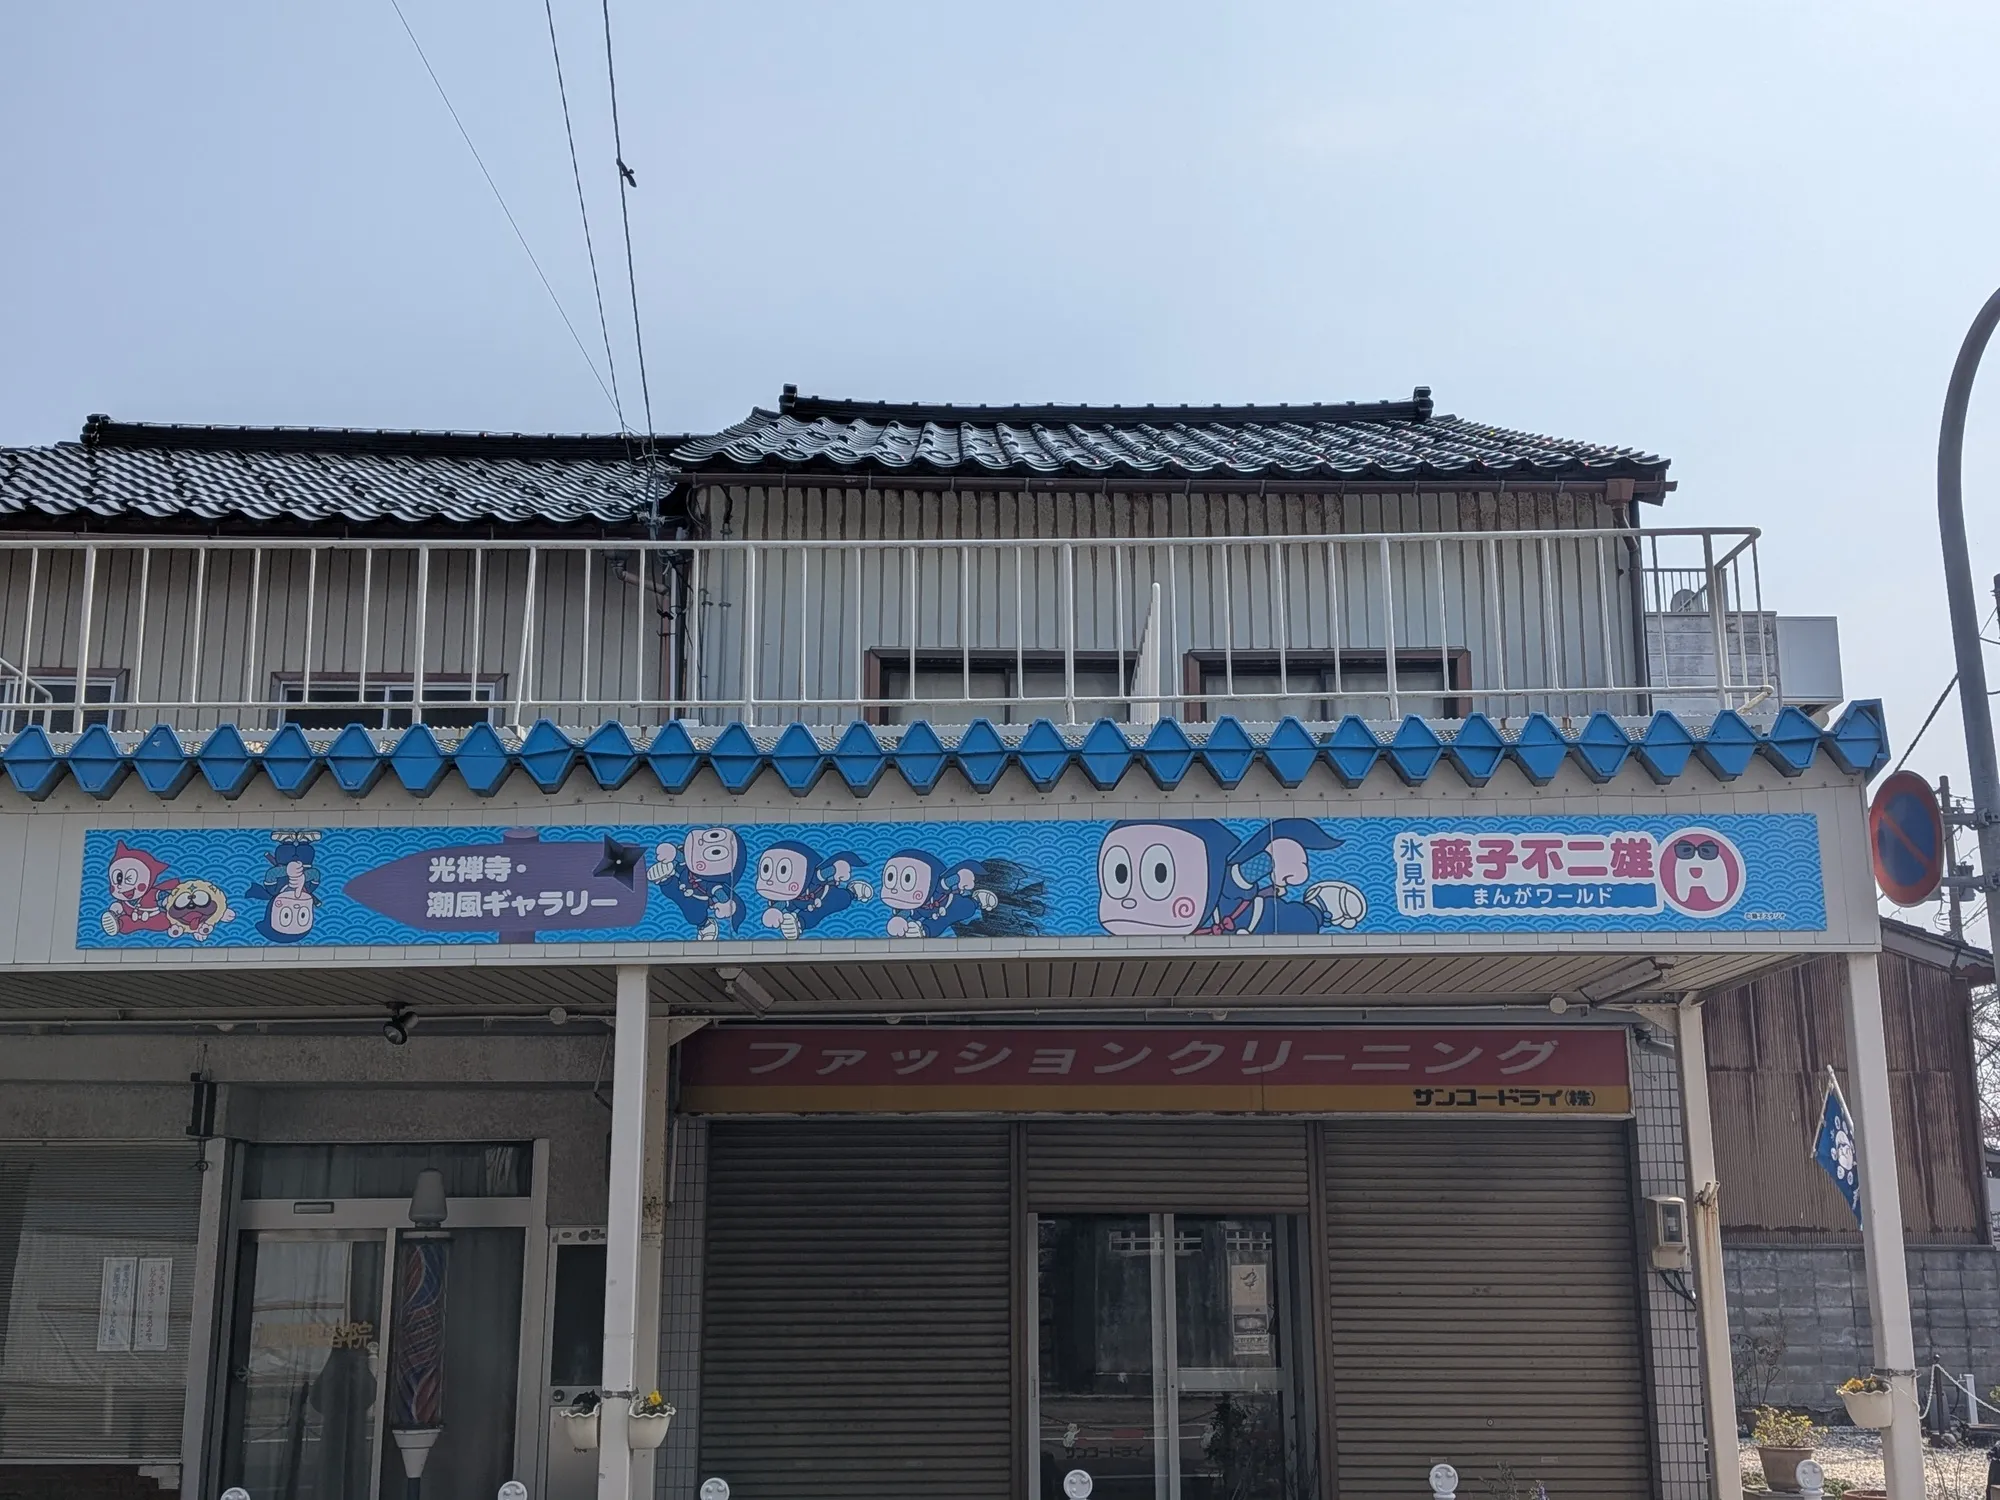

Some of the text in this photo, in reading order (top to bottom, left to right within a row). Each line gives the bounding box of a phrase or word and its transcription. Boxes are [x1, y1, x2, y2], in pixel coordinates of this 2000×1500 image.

[1400, 838, 1426, 911] 氷見市
[1429, 837, 1655, 880] 藤子不二雄
[426, 889, 618, 918] 潮風ギャラリー
[1473, 887, 1613, 906] まんがワールド
[748, 1040, 1560, 1076] ファッションクリーニング
[1413, 1088, 1596, 1107] サンコードライ(株)
